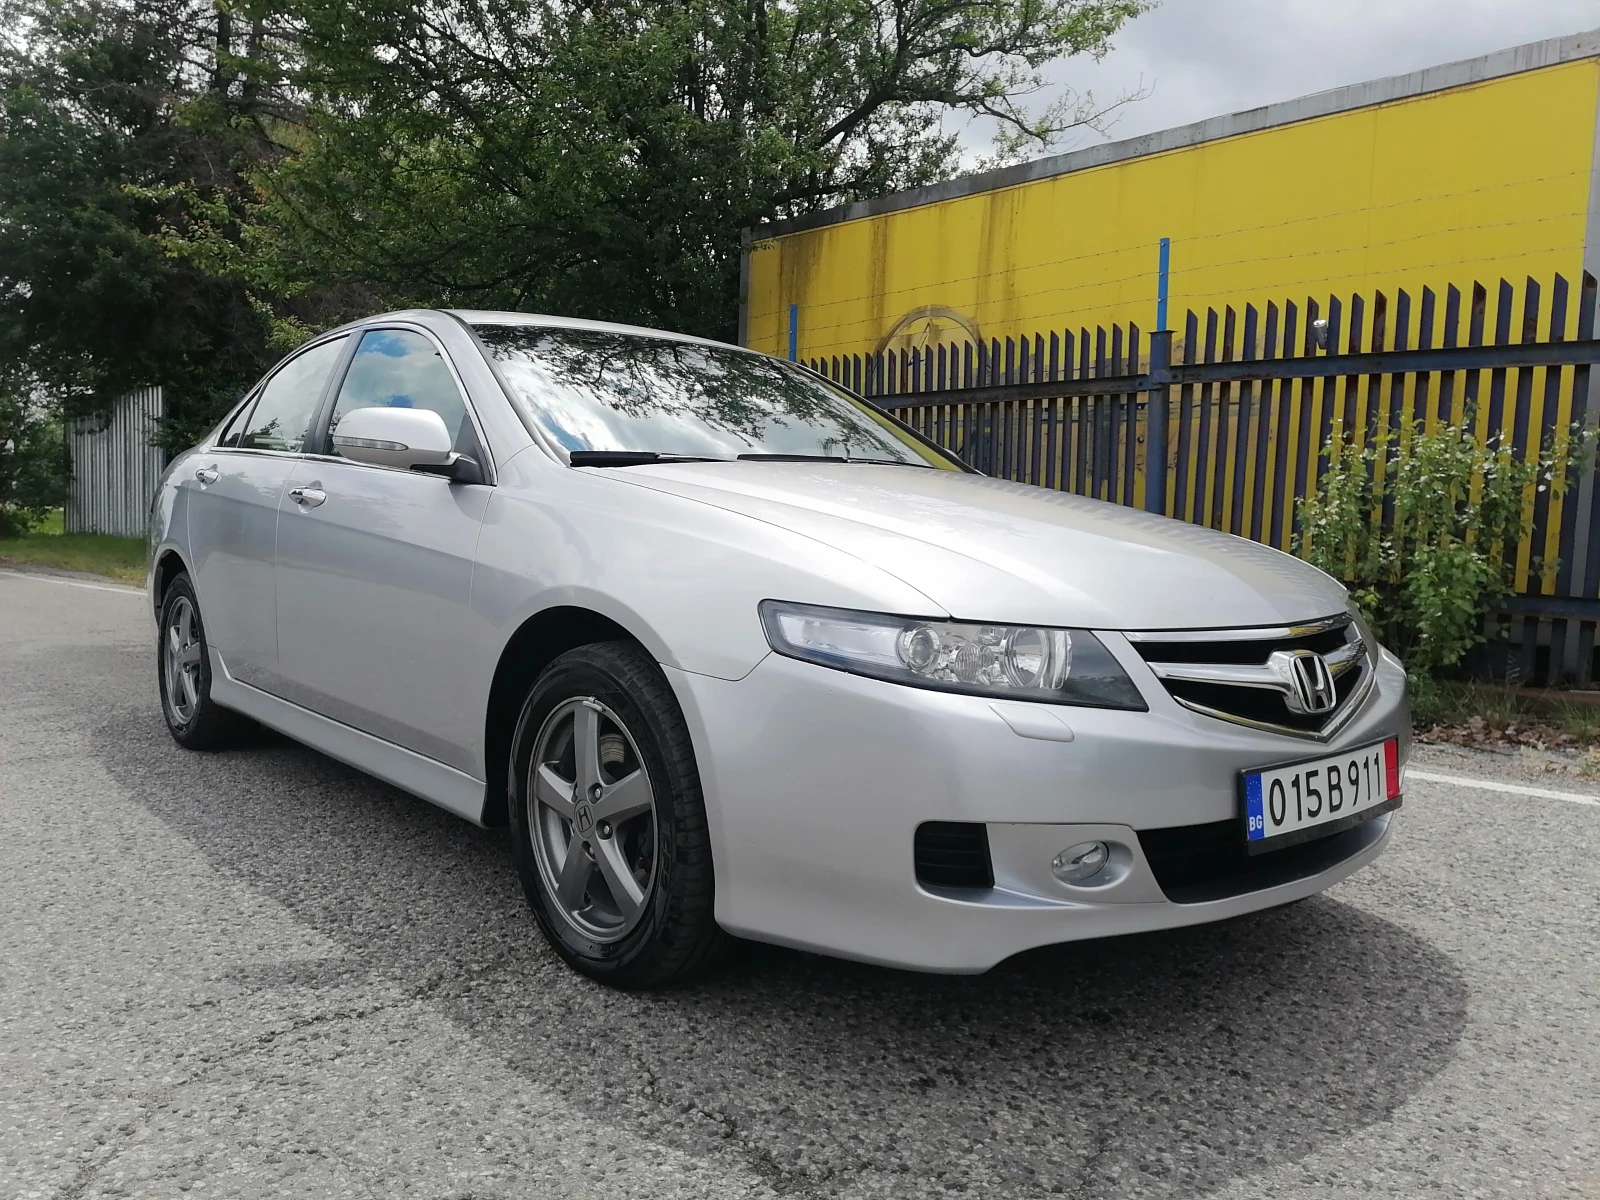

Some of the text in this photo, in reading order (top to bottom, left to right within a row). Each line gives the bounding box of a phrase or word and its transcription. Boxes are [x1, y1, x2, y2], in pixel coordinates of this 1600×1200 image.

[1294, 654, 1332, 711] H
[1269, 752, 1381, 826] 015B911
[1250, 815, 1263, 831] BG
